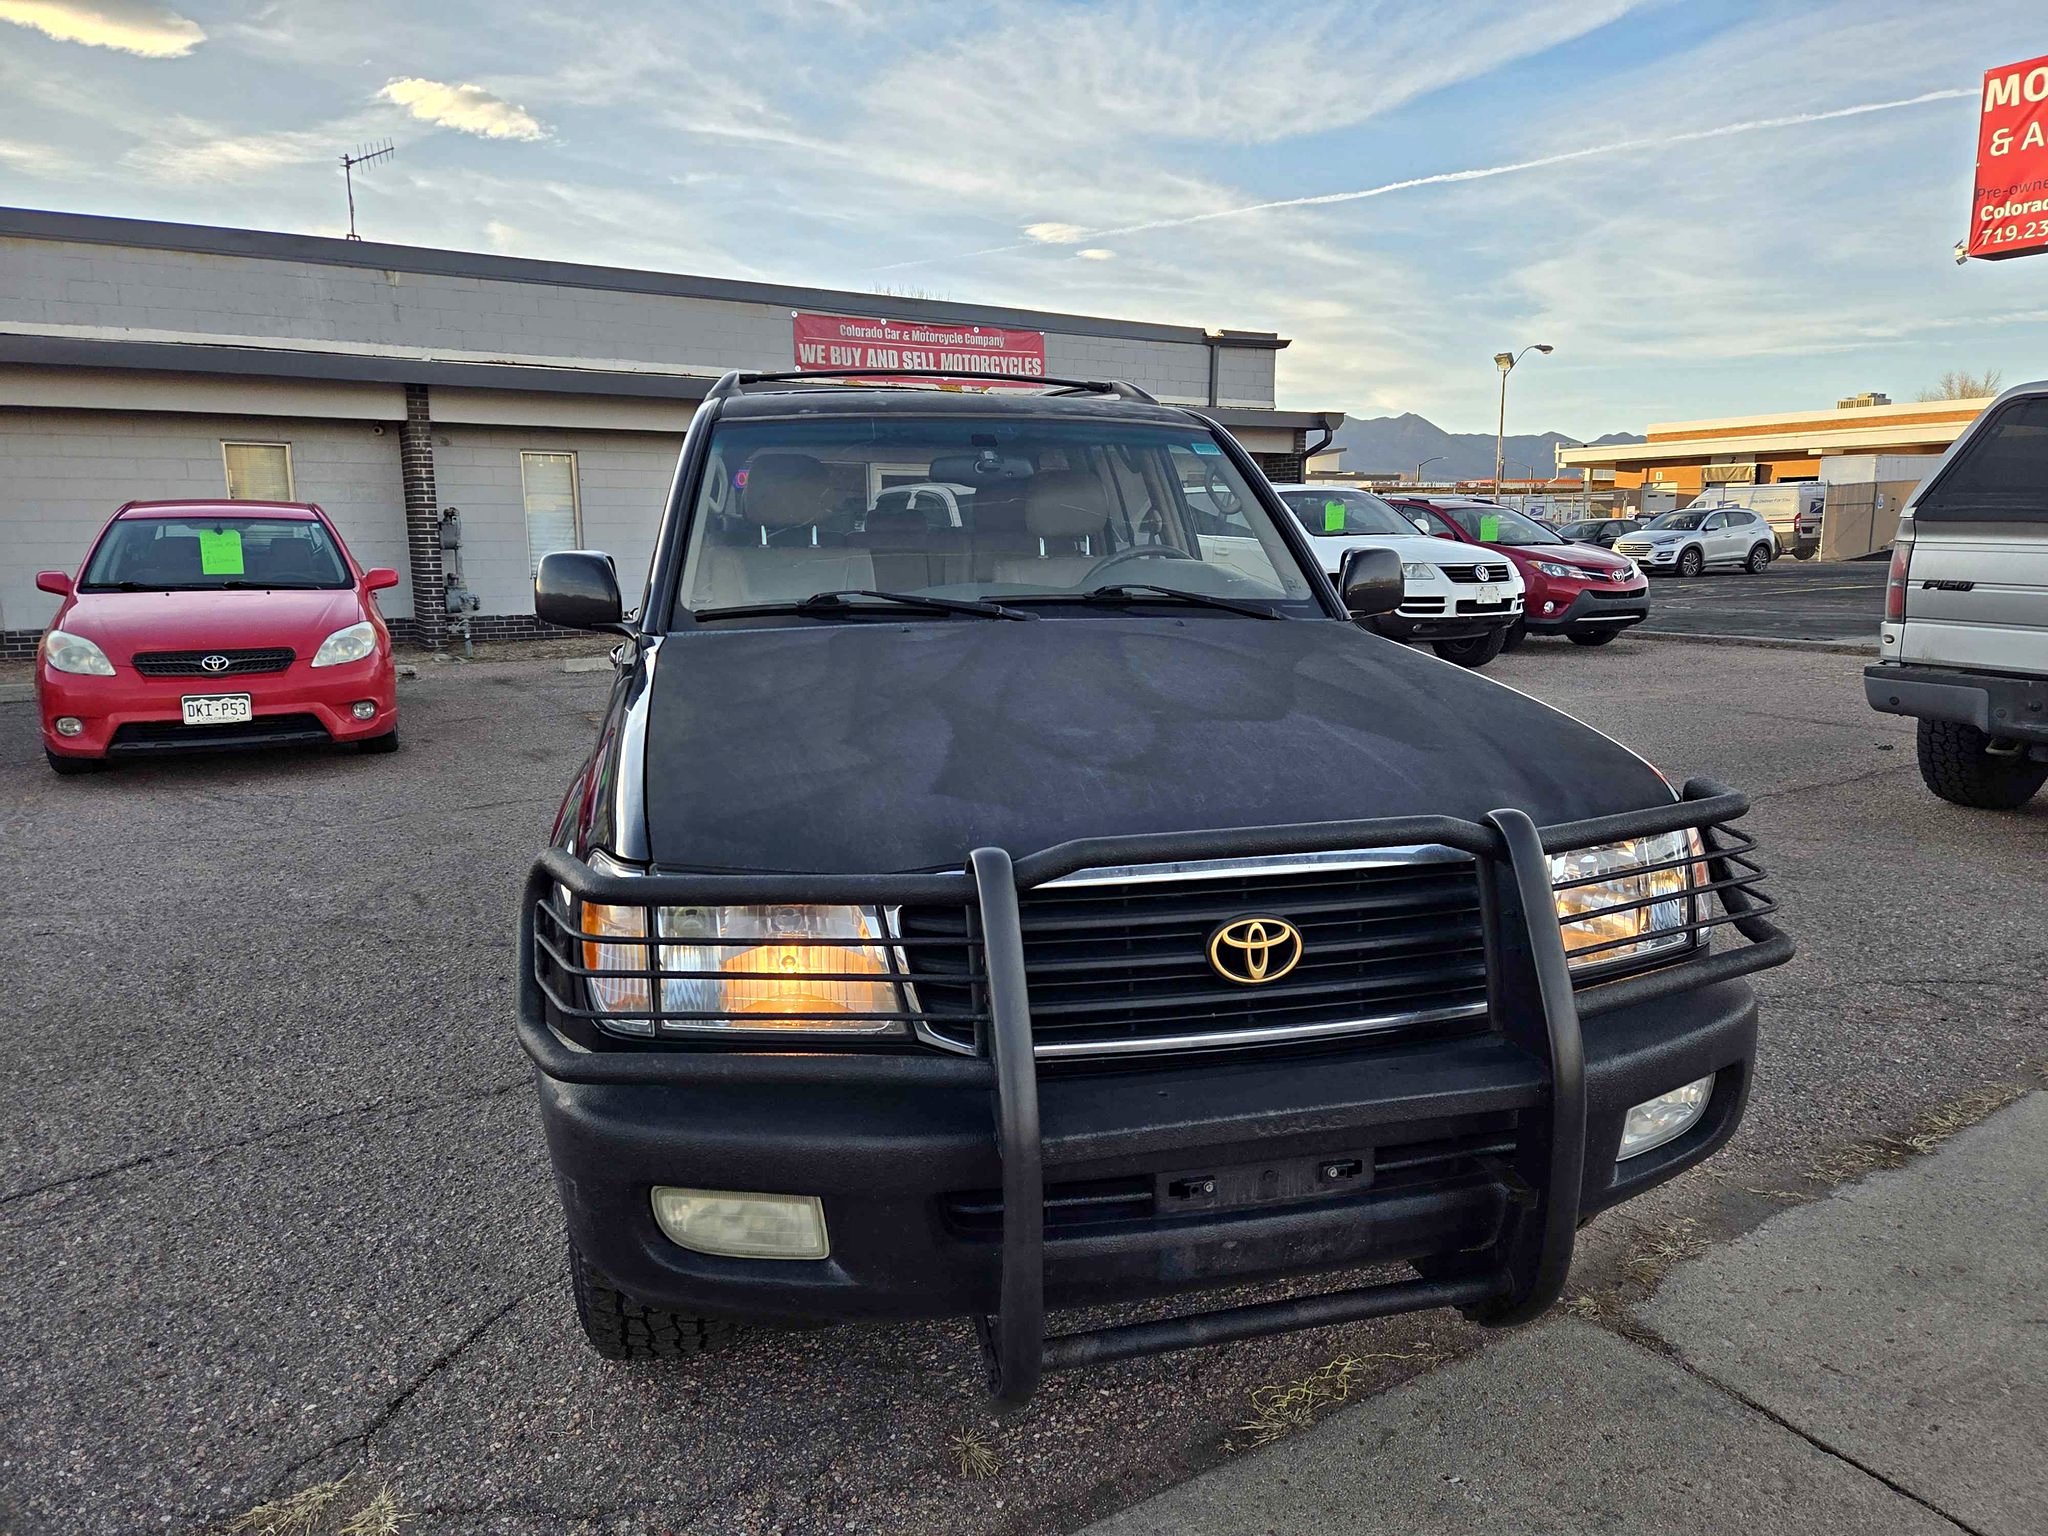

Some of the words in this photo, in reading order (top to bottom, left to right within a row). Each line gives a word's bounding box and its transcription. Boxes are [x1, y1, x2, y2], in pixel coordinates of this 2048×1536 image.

[1984, 66, 2048, 113] MO
[1989, 127, 2014, 157] &
[2021, 121, 2048, 151] A
[839, 325, 883, 339] Colorado
[884, 328, 900, 340] Car
[902, 331, 910, 341] &
[911, 330, 963, 345] Motorcycle
[965, 335, 1005, 348] Company
[798, 343, 826, 364] WE
[830, 345, 862, 367] BUY
[867, 348, 899, 369] AND
[902, 351, 937, 370] SELL
[940, 352, 1042, 376] MOTORCYCLES
